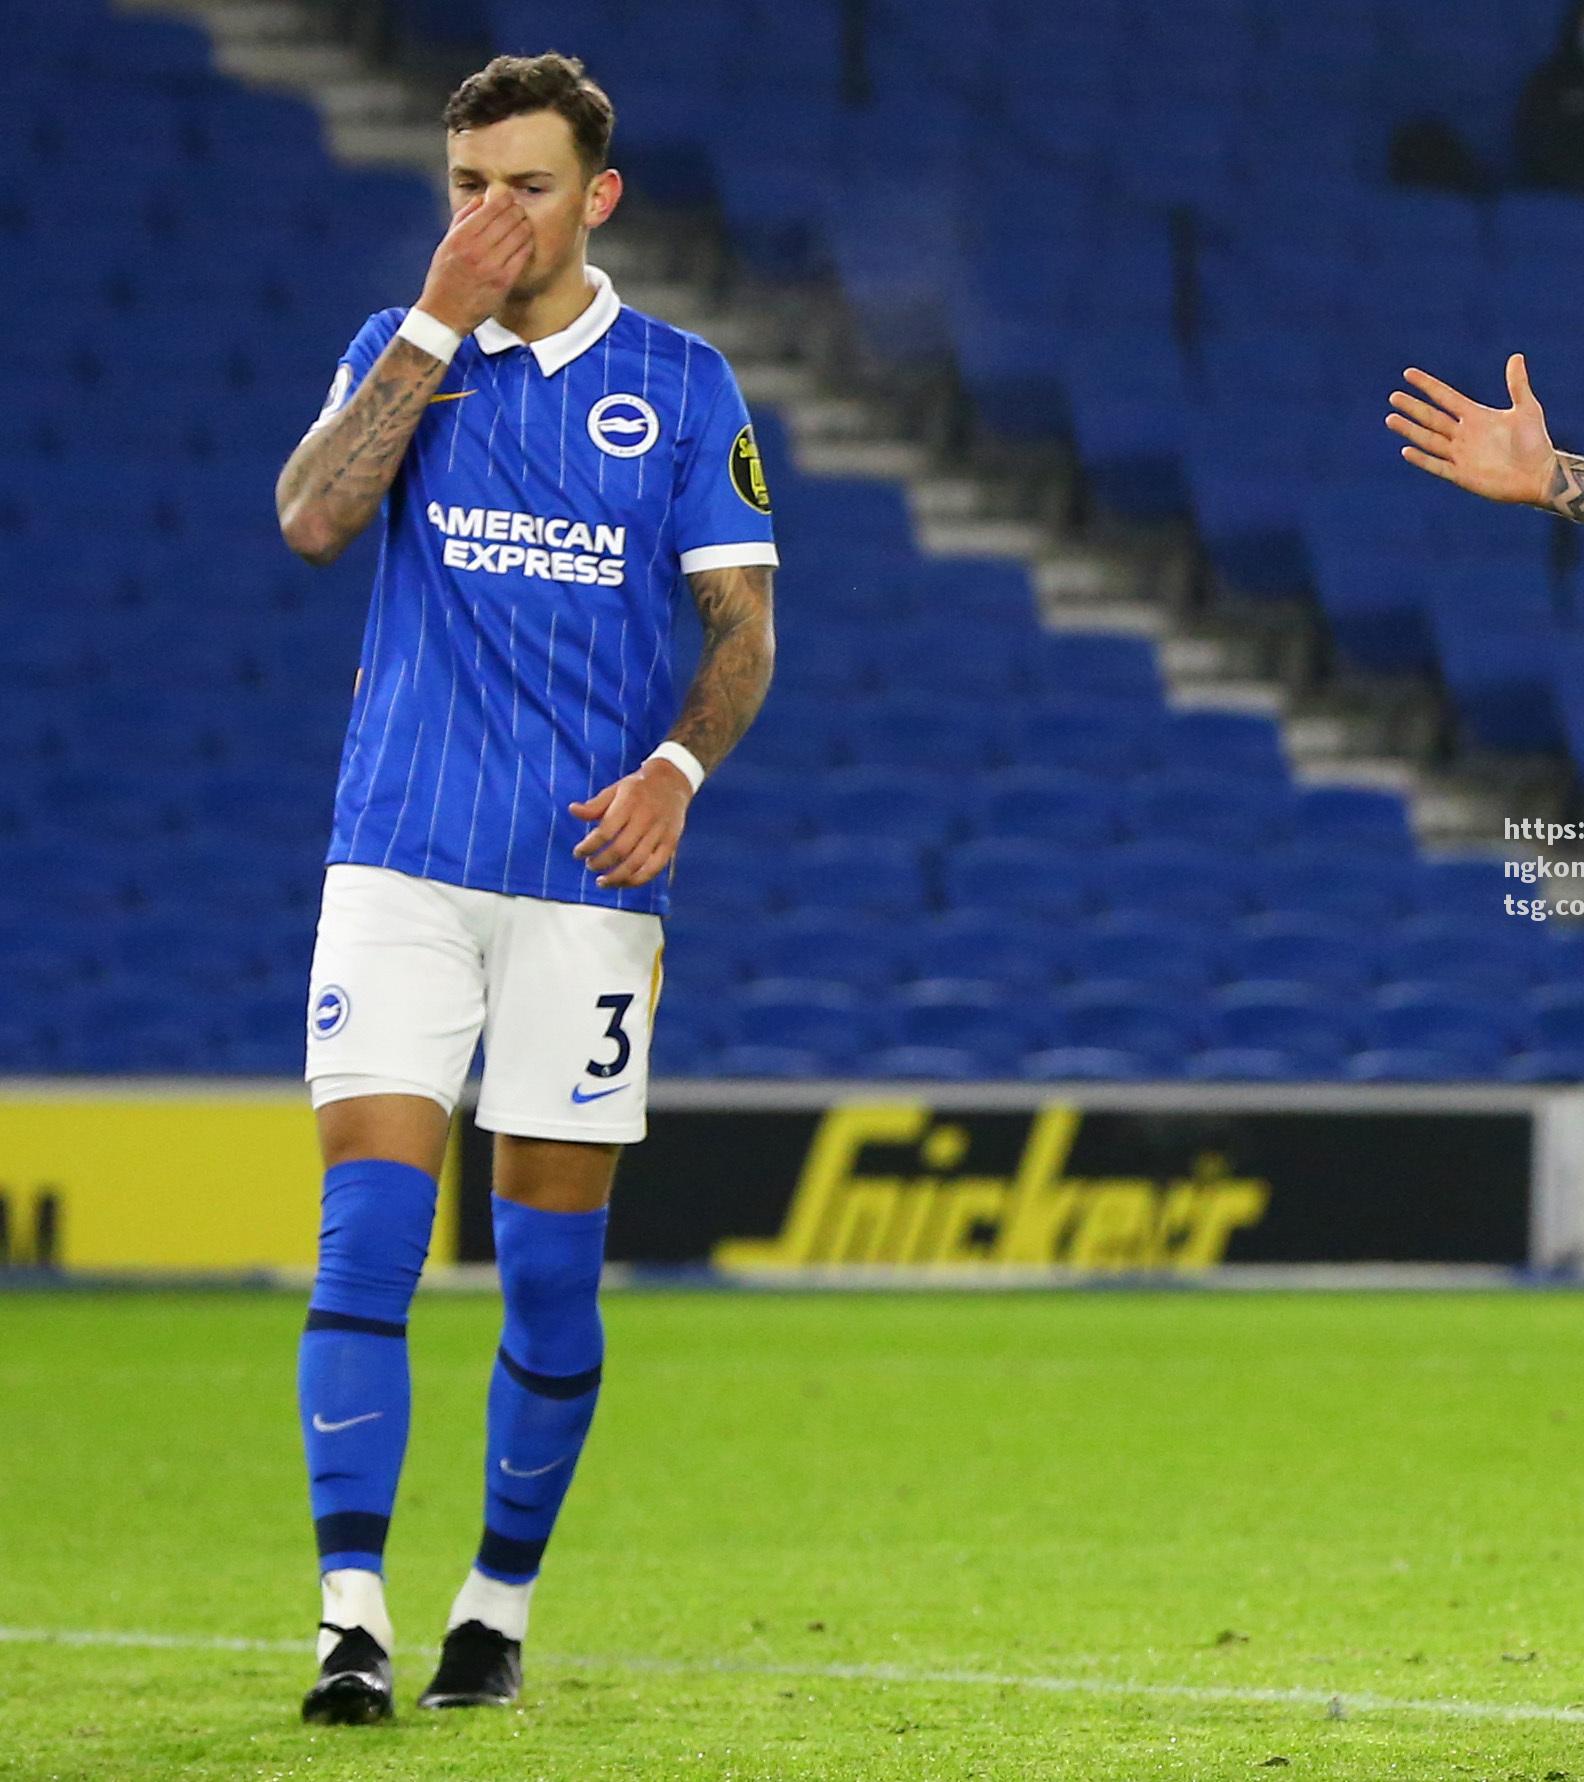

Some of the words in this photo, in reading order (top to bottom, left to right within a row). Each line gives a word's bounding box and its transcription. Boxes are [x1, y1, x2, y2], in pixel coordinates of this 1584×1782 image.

[427, 501, 626, 555] AMERICAN
[443, 538, 626, 587] EXPRESS
[586, 993, 635, 1078] 3
